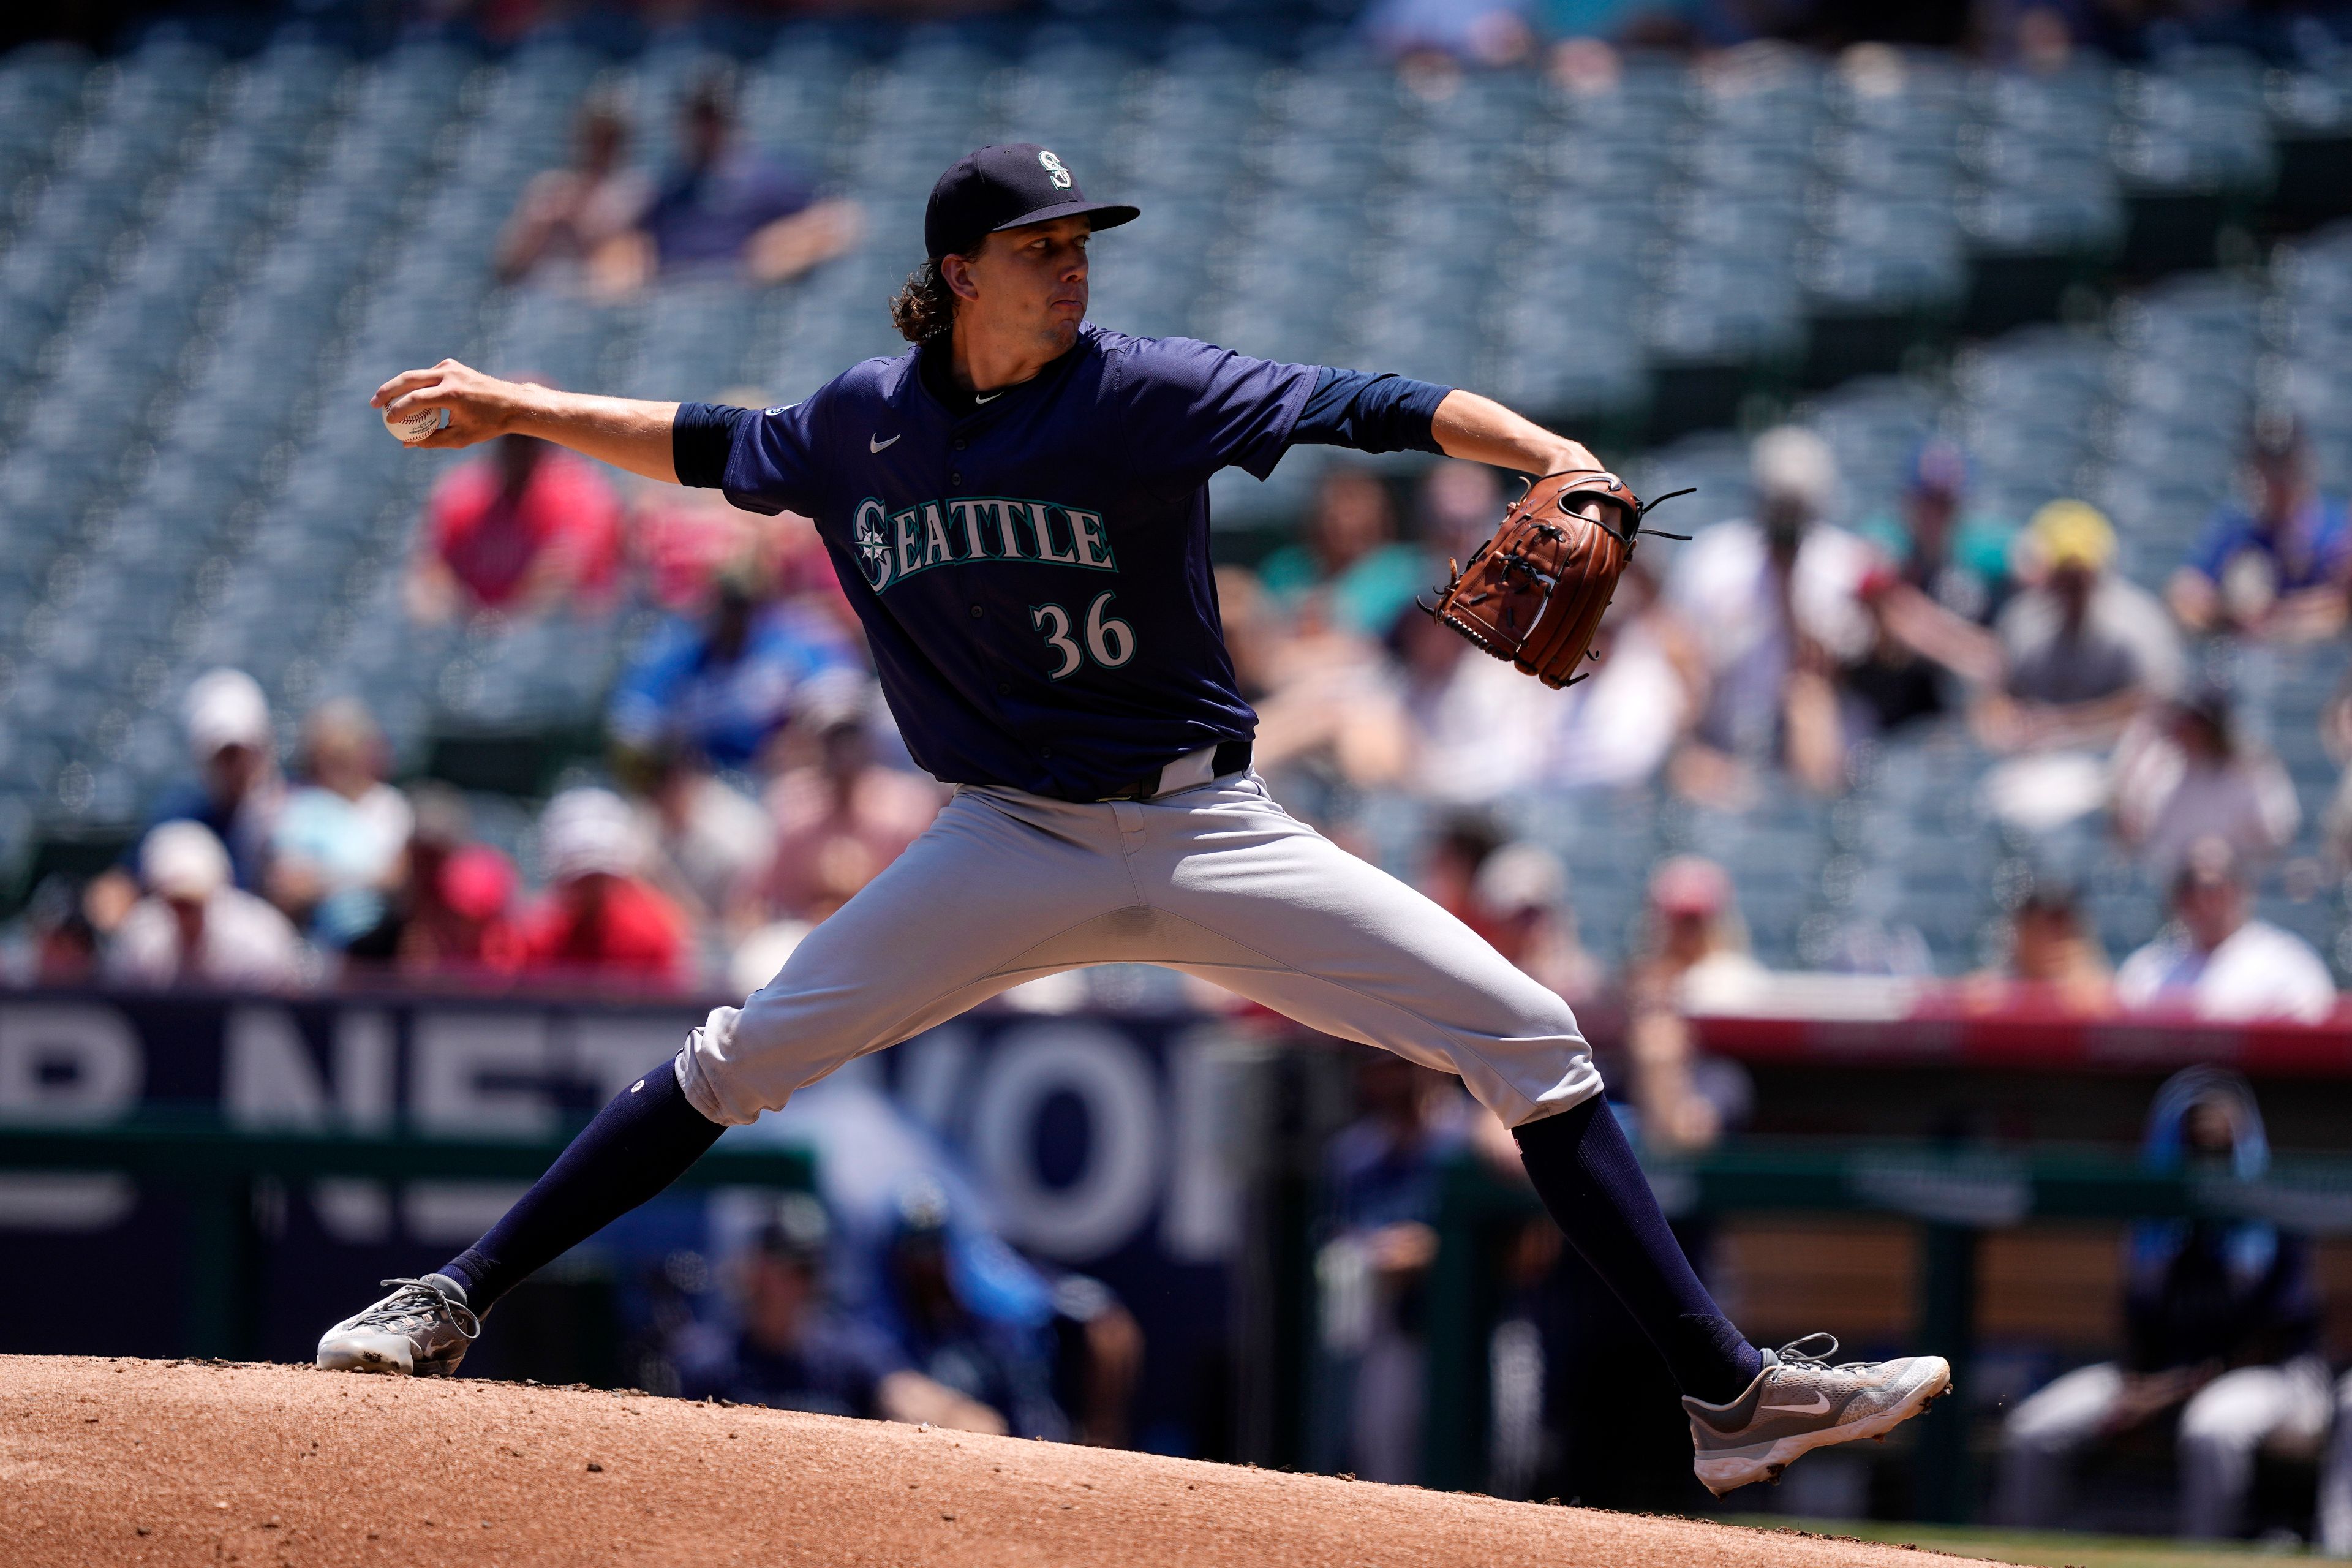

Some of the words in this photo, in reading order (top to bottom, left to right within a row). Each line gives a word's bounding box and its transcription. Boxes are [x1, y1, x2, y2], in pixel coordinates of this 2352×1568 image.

[1038, 150, 1072, 190] S
[852, 496, 1120, 596] SEATTLE
[1029, 589, 1137, 682] 36
